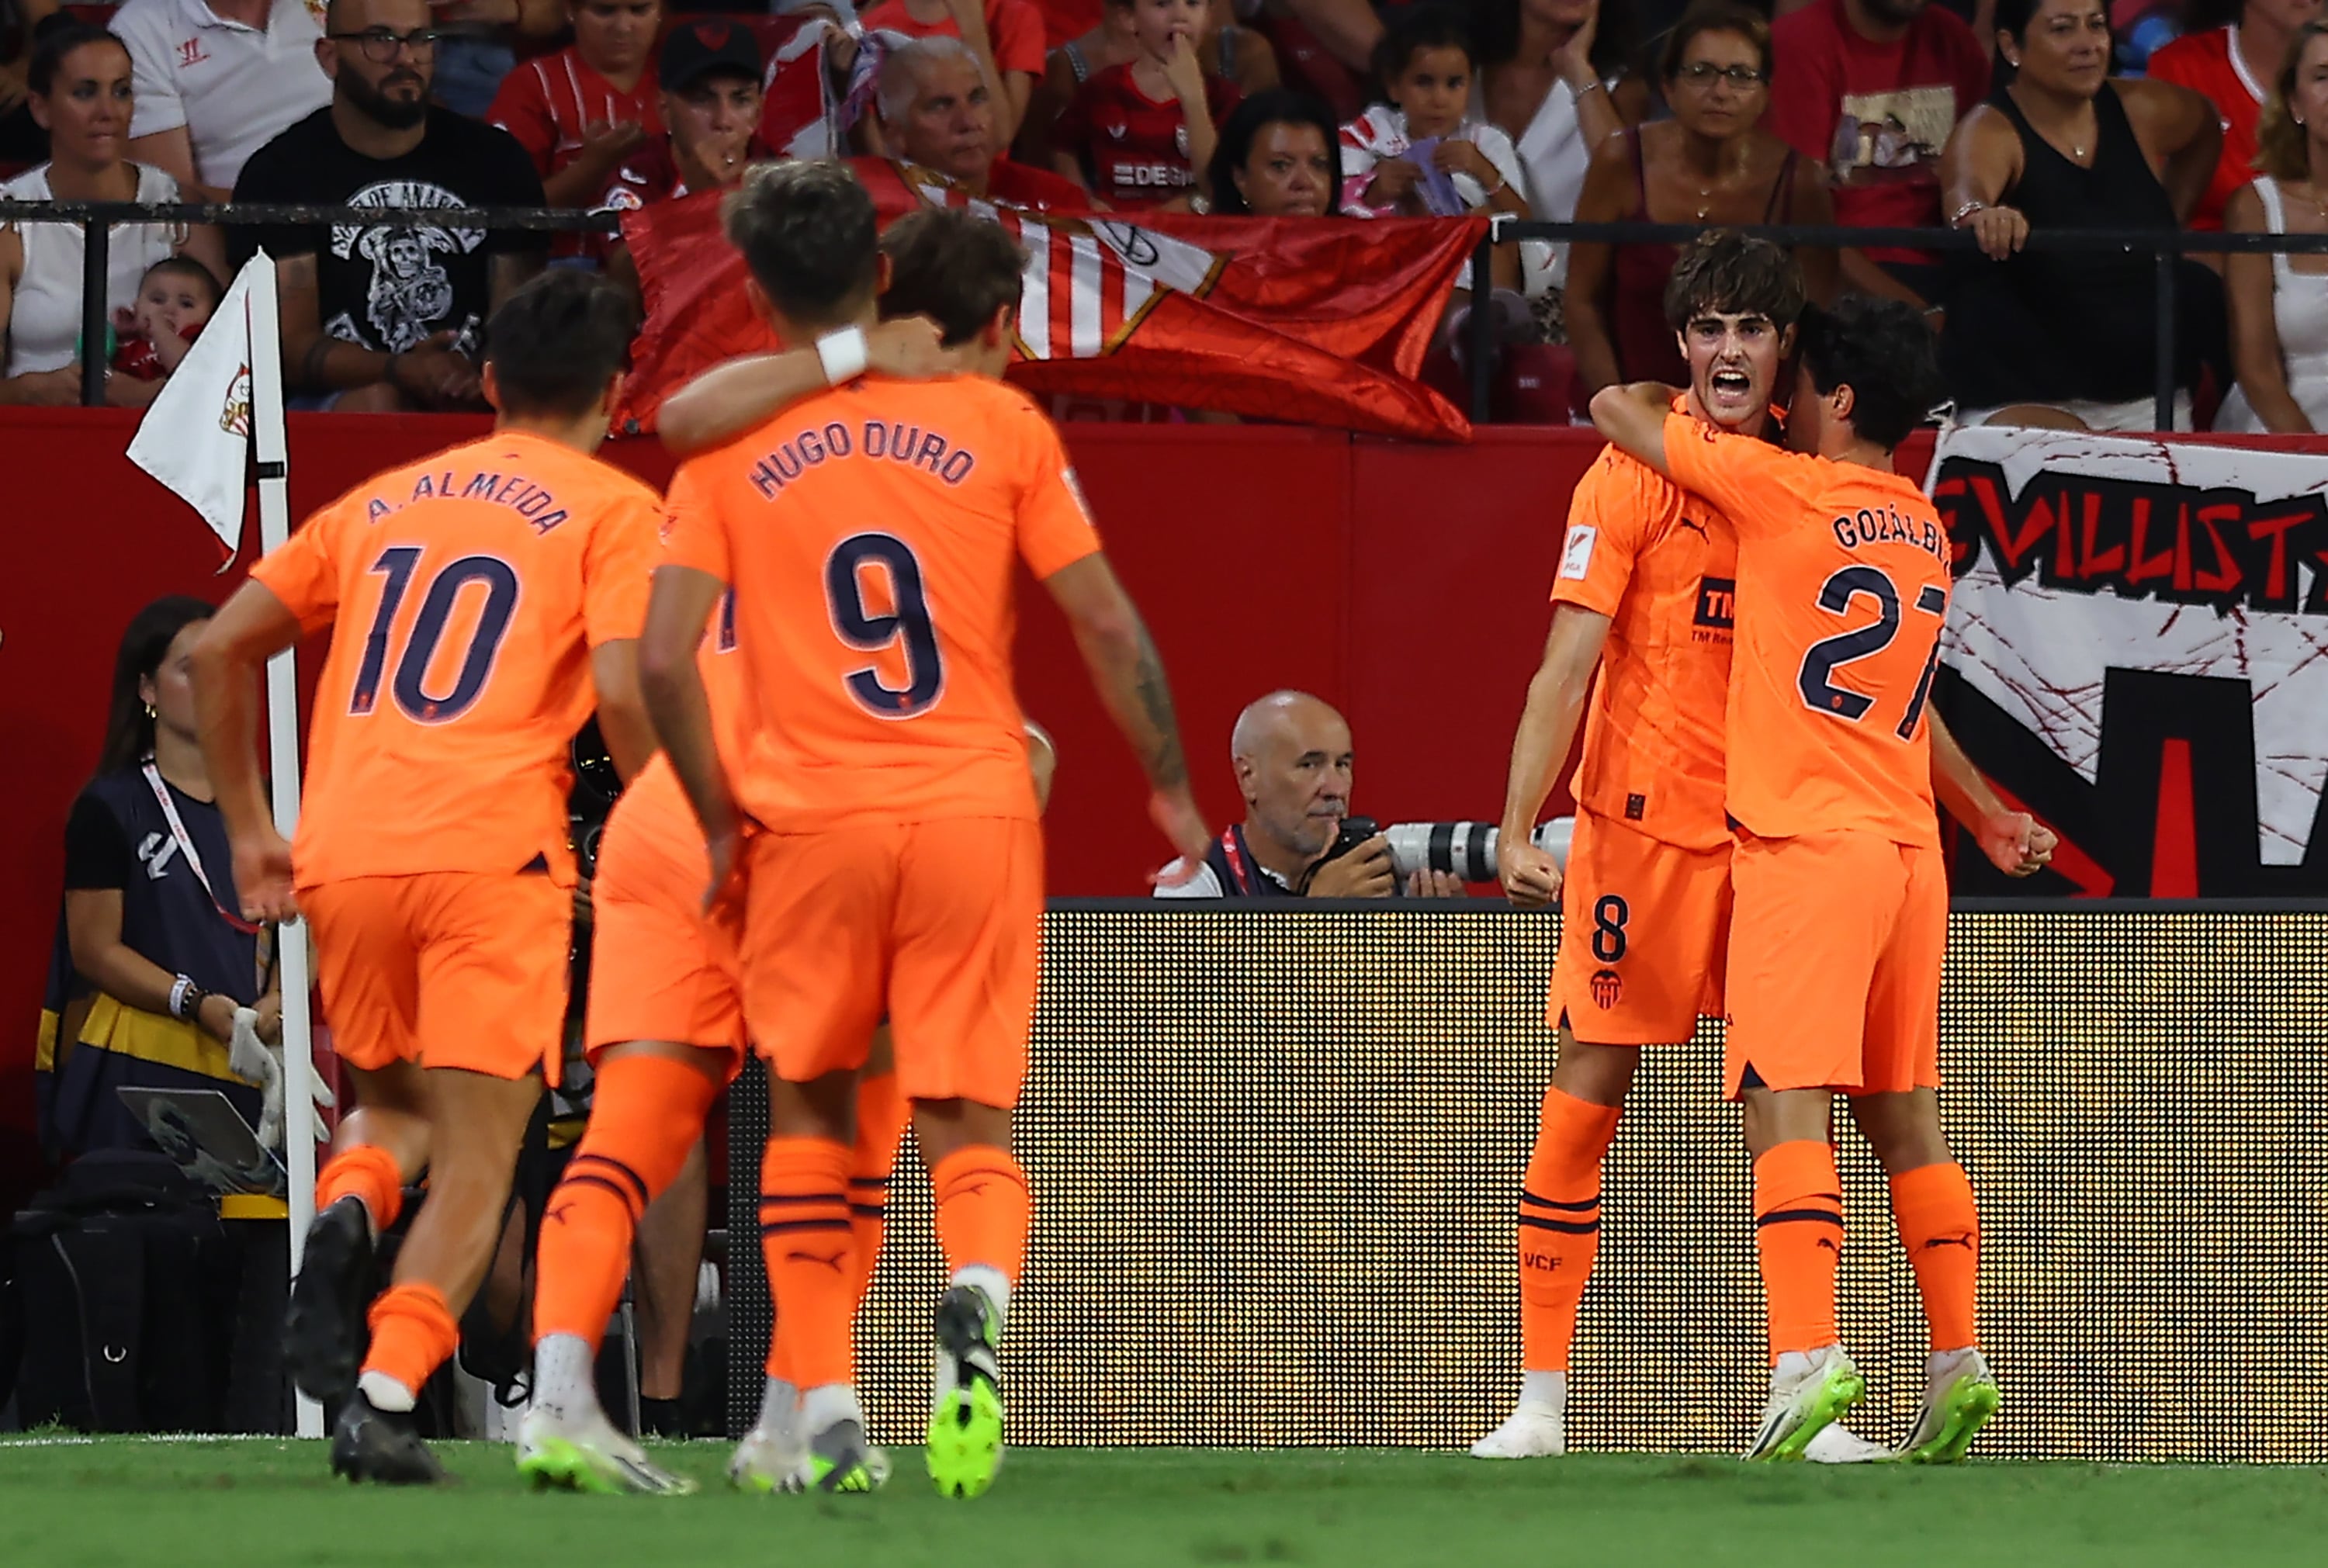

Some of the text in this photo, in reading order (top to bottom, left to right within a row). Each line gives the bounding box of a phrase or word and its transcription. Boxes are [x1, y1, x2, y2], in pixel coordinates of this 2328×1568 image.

[748, 421, 975, 501] HUGO DURO
[367, 471, 570, 536] A. ALMEIDA
[346, 545, 521, 726] 10
[823, 531, 945, 722] 9
[1796, 564, 1947, 742] 27
[1592, 894, 1629, 964] 8
[1523, 1251, 1563, 1272] VCF
